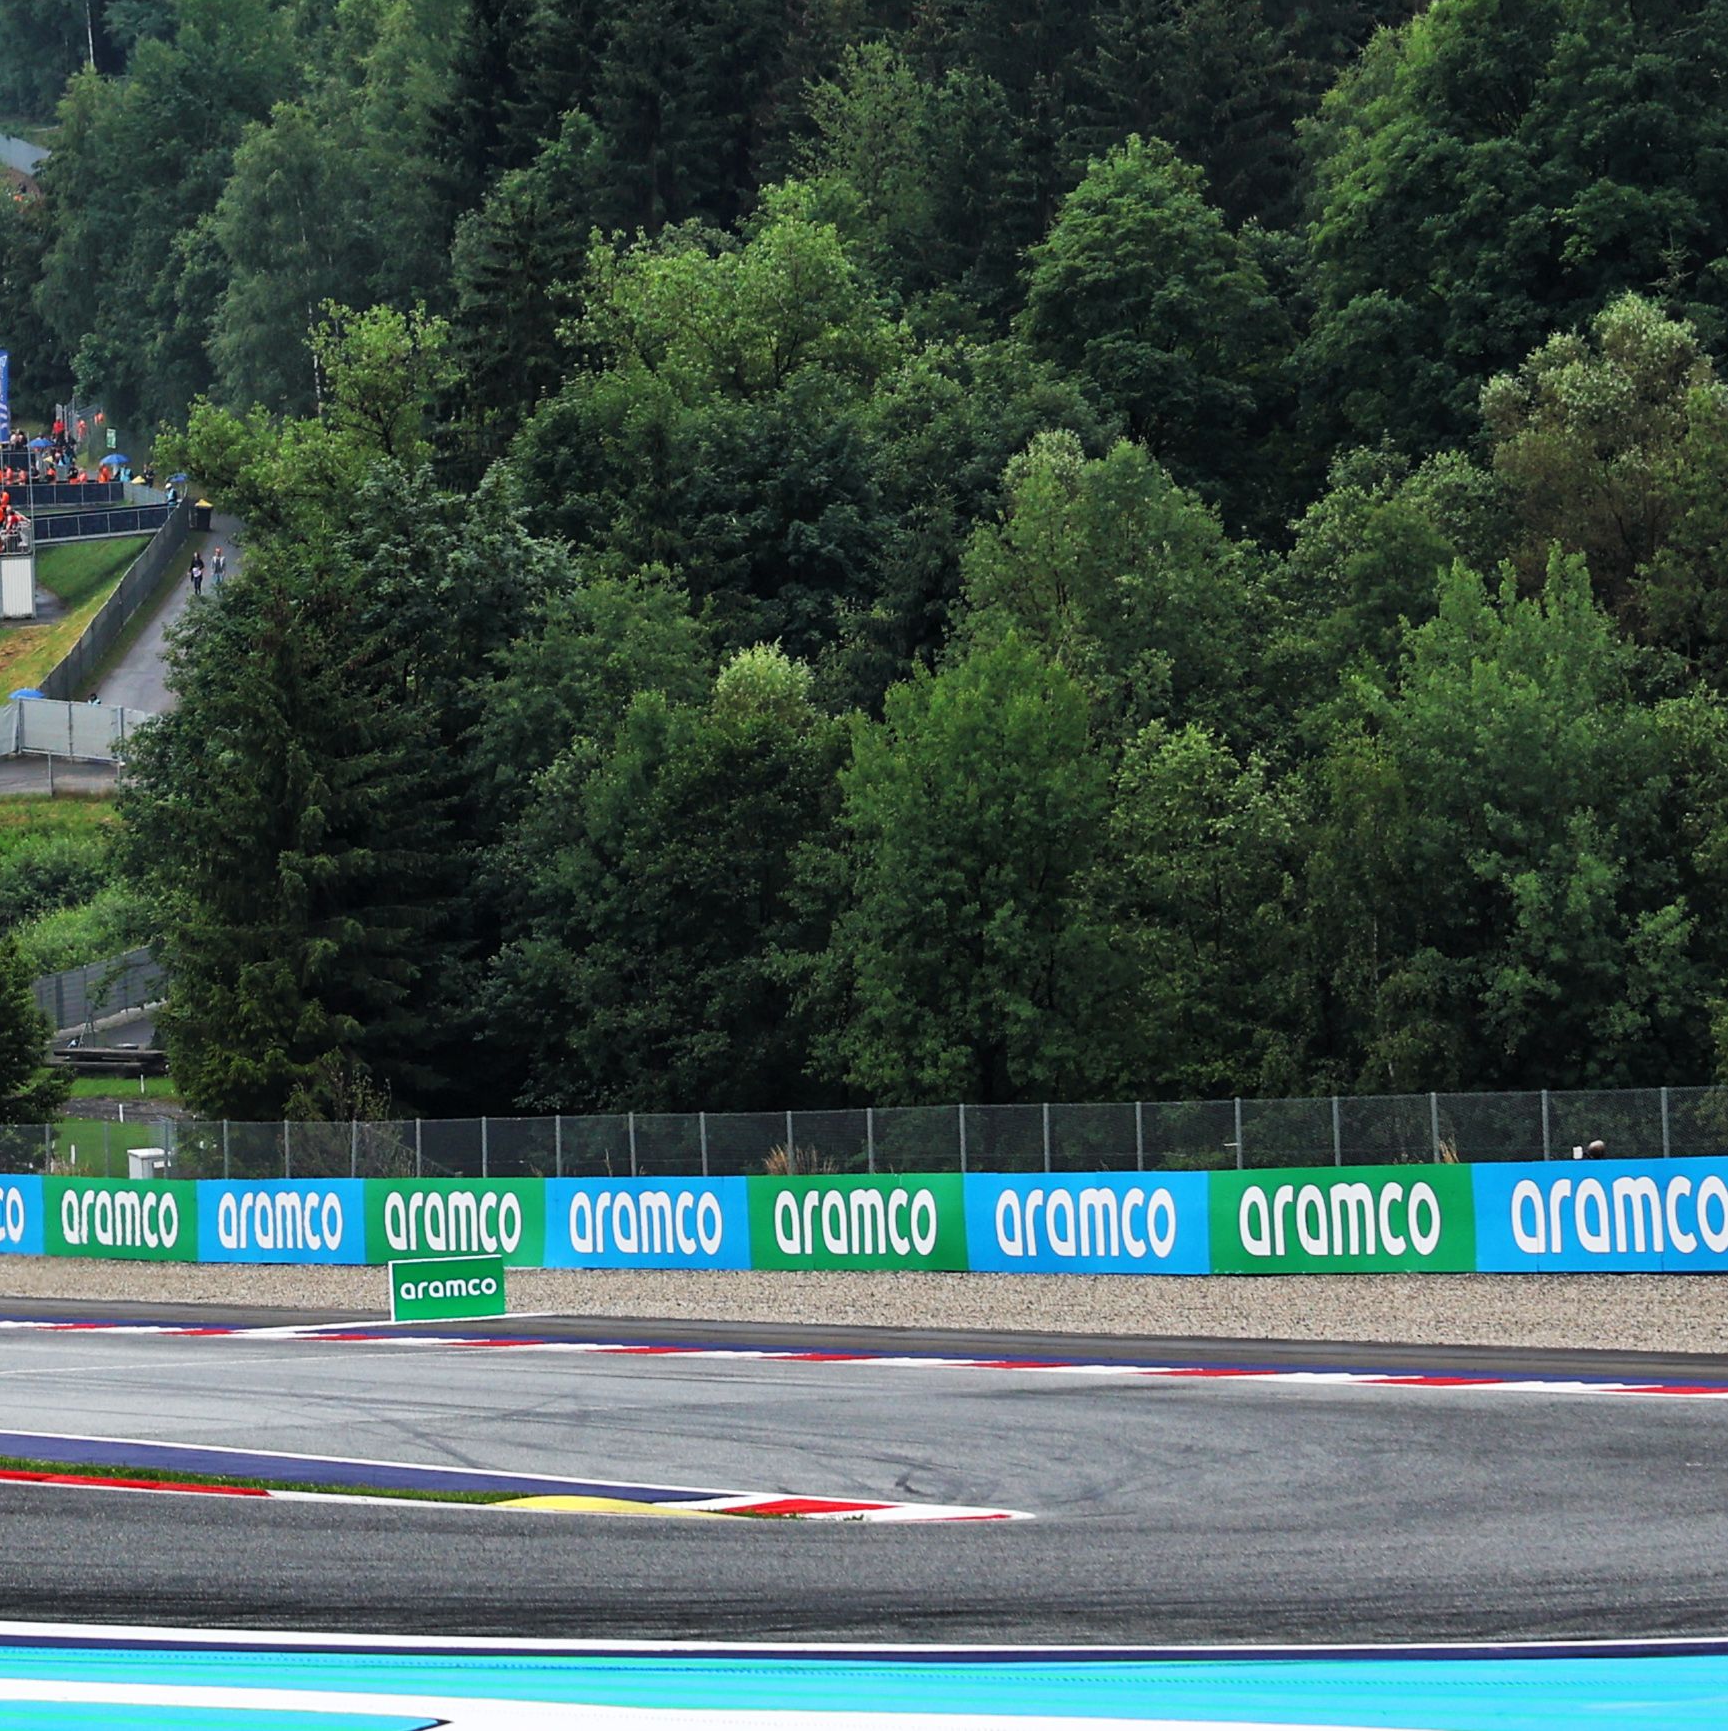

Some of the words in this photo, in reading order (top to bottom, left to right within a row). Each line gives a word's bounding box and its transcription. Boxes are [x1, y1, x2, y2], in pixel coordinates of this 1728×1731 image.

[61, 1189, 178, 1248] aramco
[218, 1191, 343, 1251] aramco
[384, 1191, 522, 1252] aramco
[569, 1191, 723, 1255] aramco
[774, 1188, 937, 1256] aramco
[995, 1188, 1176, 1257] aramco
[1239, 1182, 1441, 1256] aramco
[1511, 1175, 1728, 1254] aramco
[400, 1277, 497, 1300] aramco
